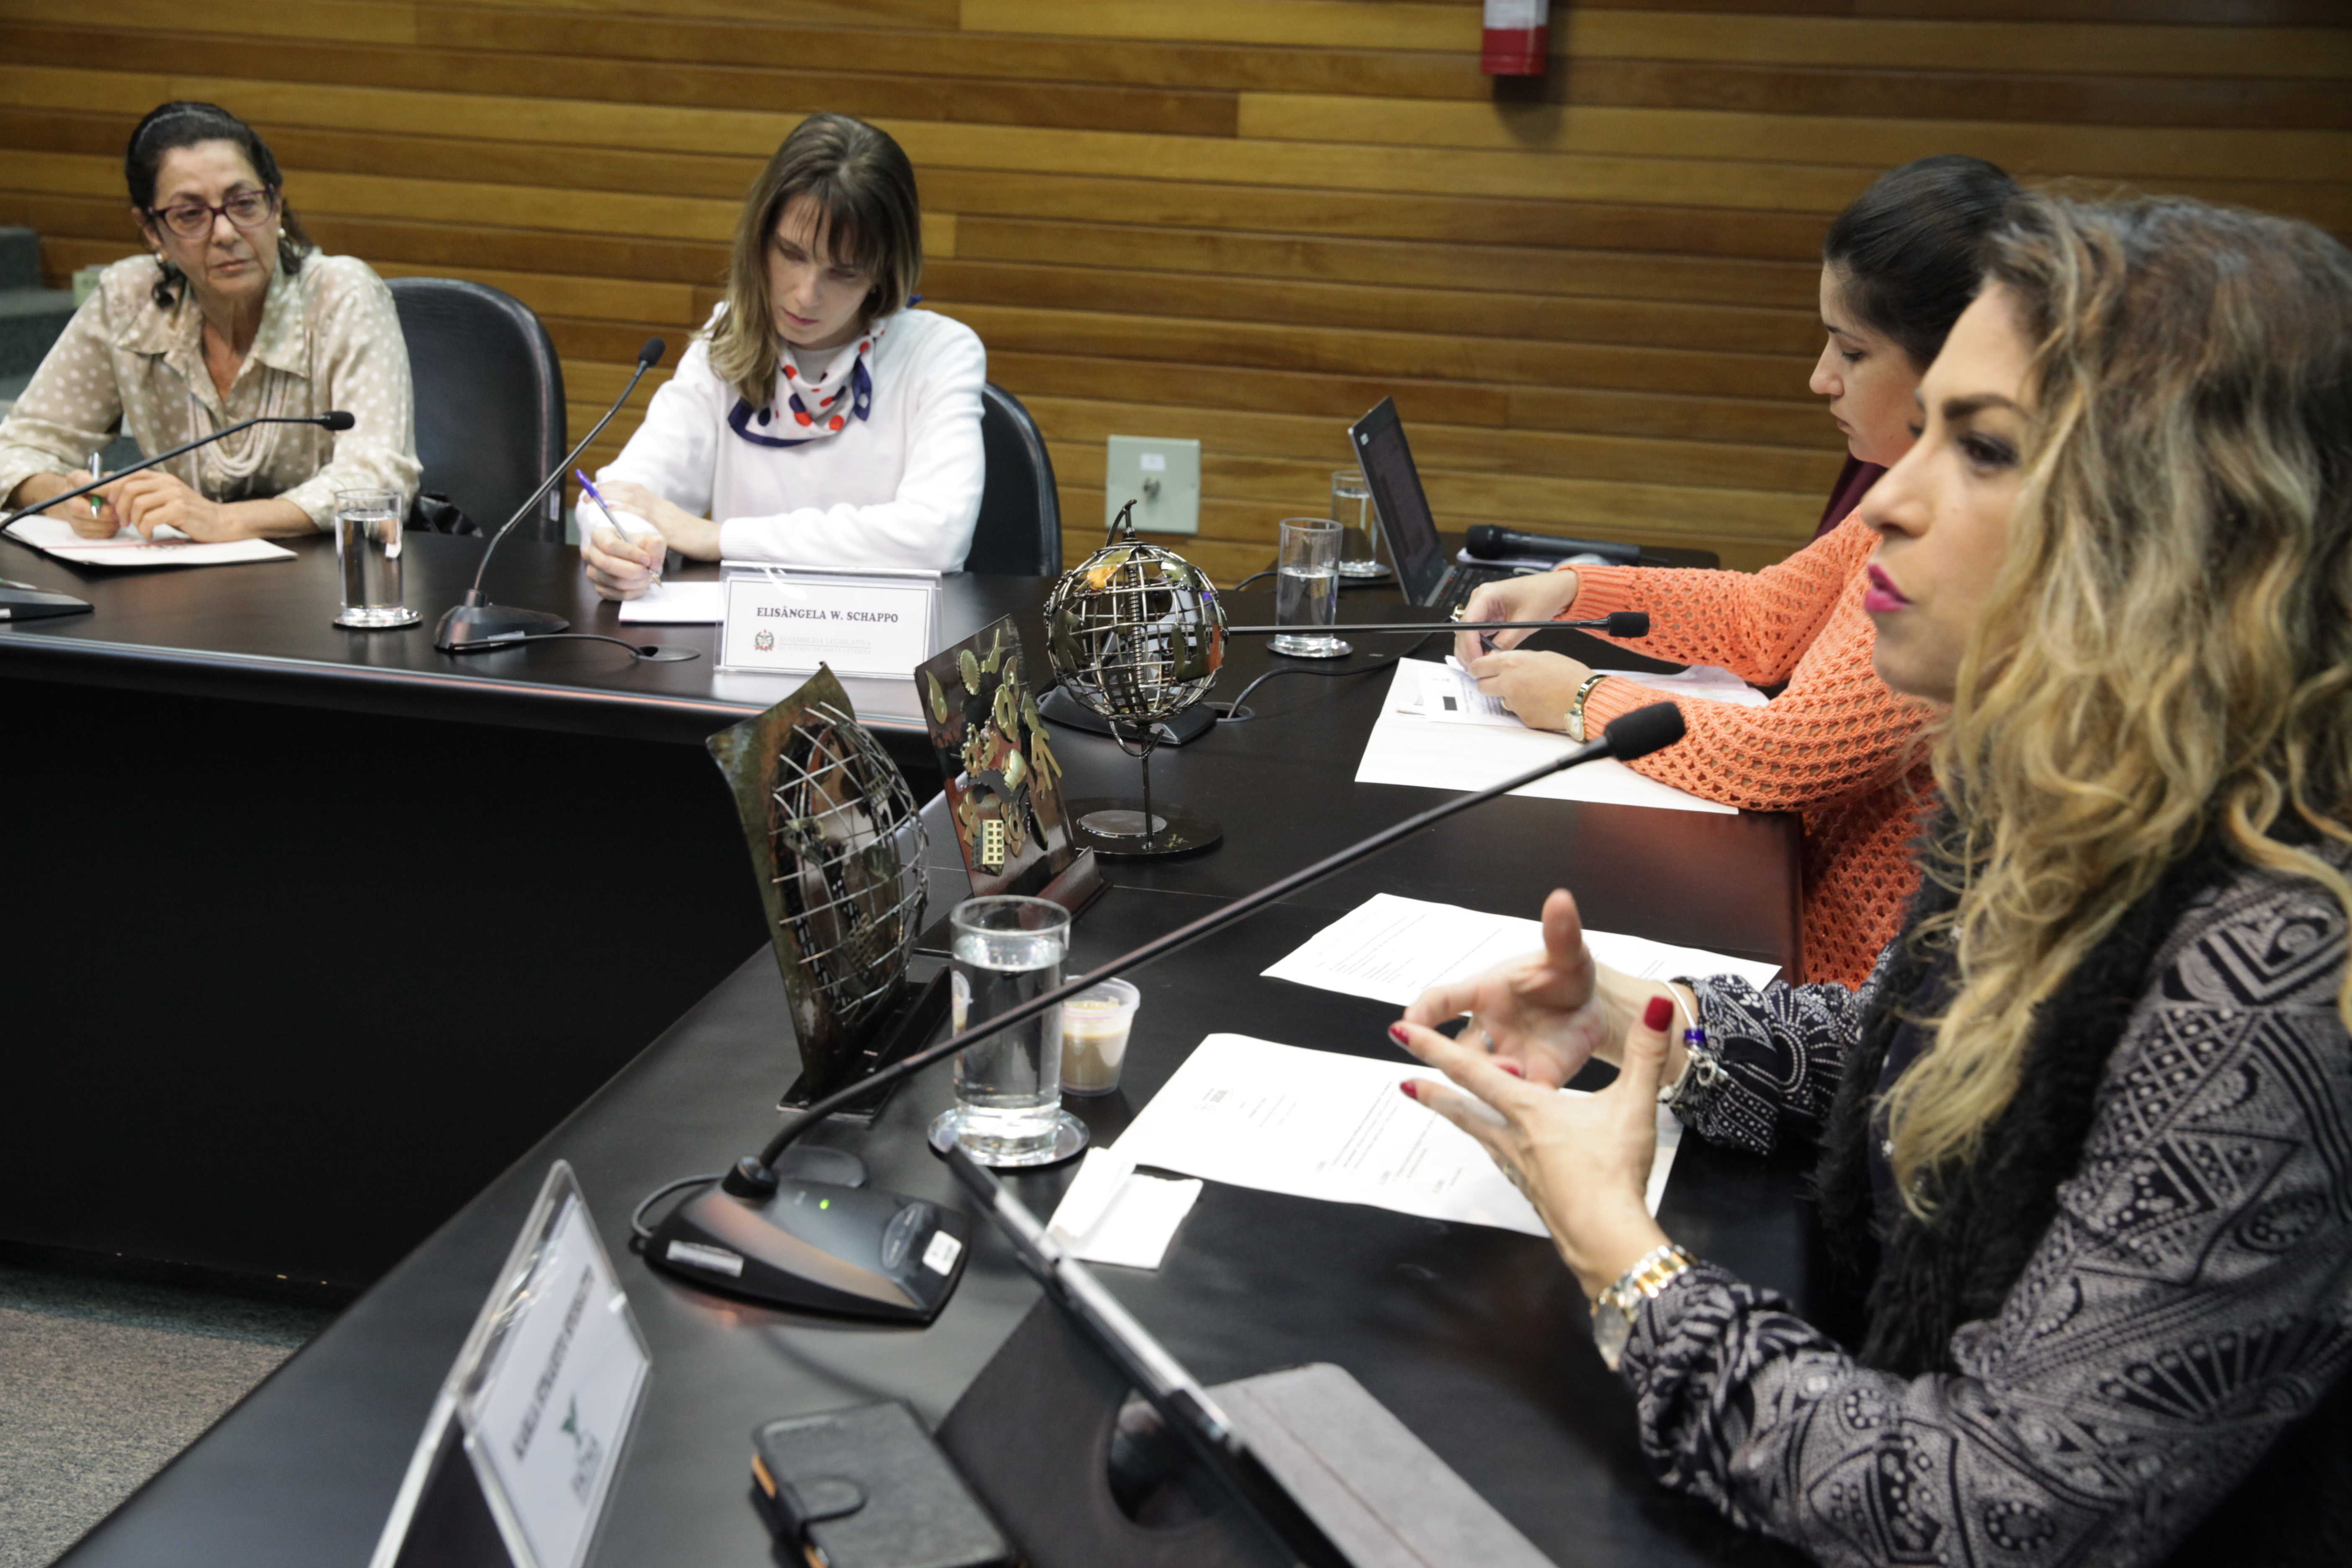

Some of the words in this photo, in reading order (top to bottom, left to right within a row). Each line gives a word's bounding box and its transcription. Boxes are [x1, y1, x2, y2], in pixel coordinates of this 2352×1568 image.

[757, 606, 826, 620] ELISÂNGELA
[830, 611, 843, 620] W.
[847, 612, 898, 623] SCHAPPO
[779, 636, 823, 644] ASSEMBLEIA
[826, 638, 871, 647] LEGISLATIVA
